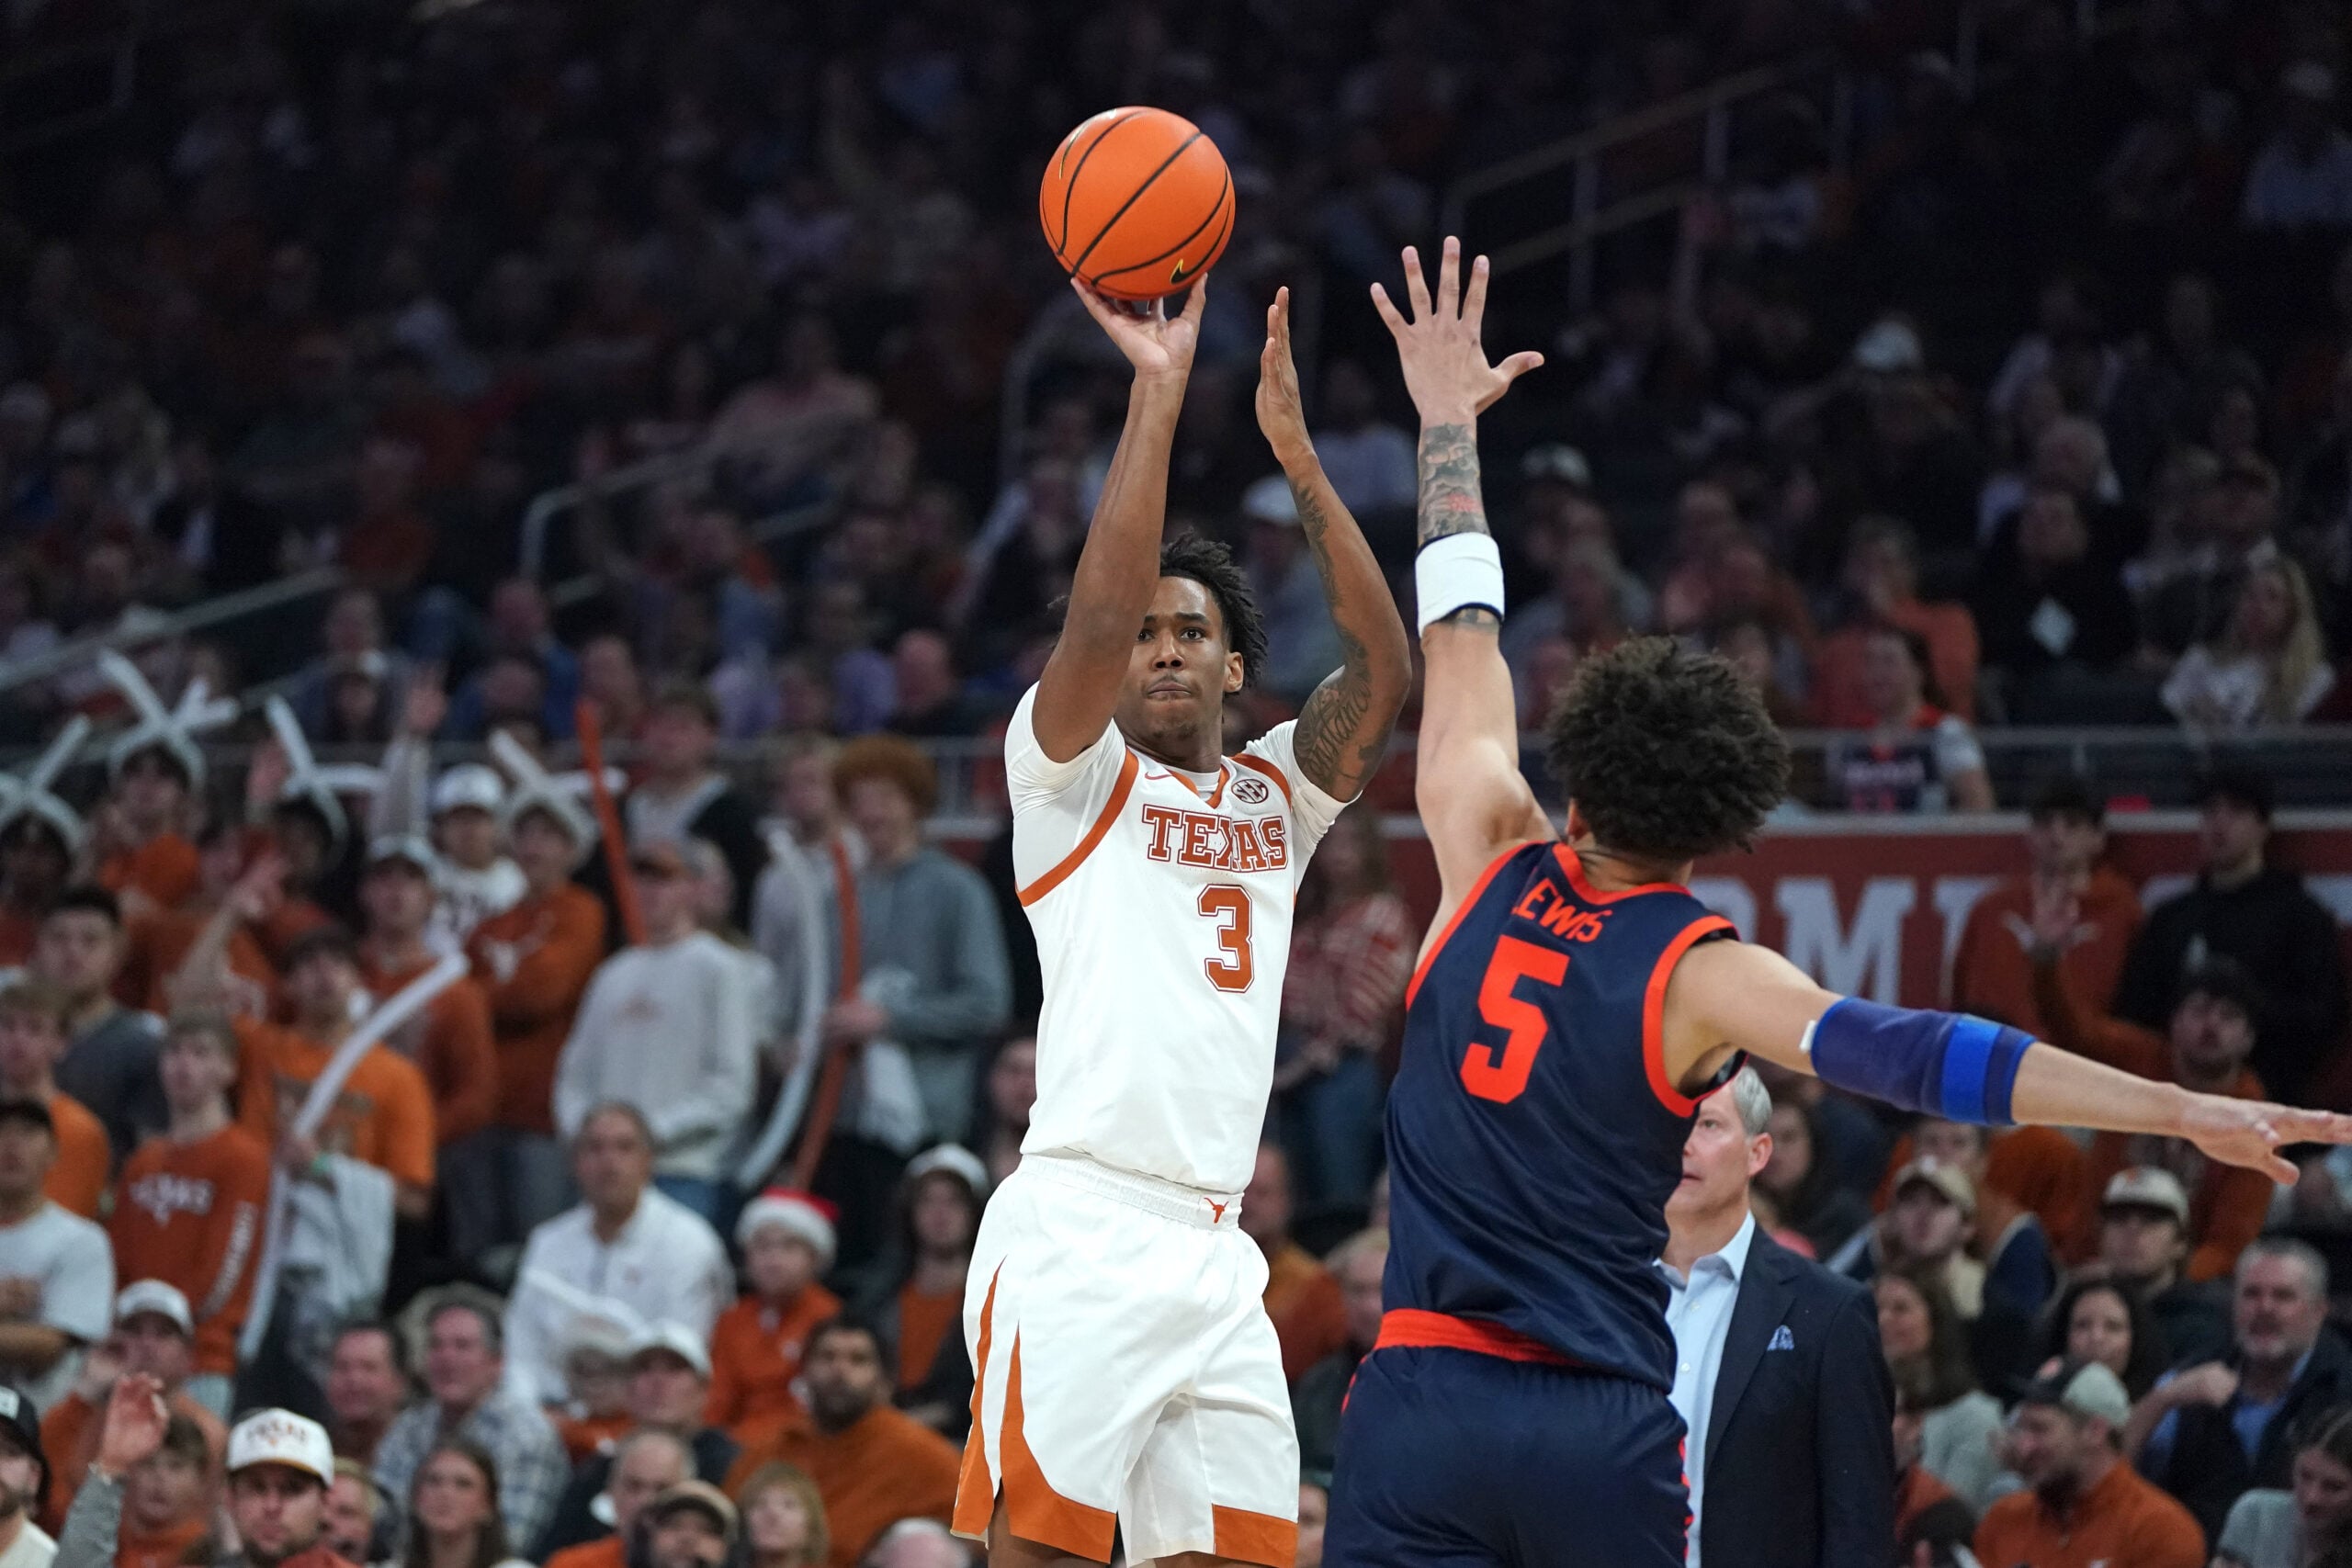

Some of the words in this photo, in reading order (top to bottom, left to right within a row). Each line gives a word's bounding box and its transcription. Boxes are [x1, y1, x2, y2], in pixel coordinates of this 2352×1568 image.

[1231, 779, 1269, 804] SEC
[1142, 804, 1288, 873] TEXAS
[1197, 884, 1255, 993] 3
[1511, 877, 1612, 942] EWIS
[1459, 933, 1570, 1104] 5
